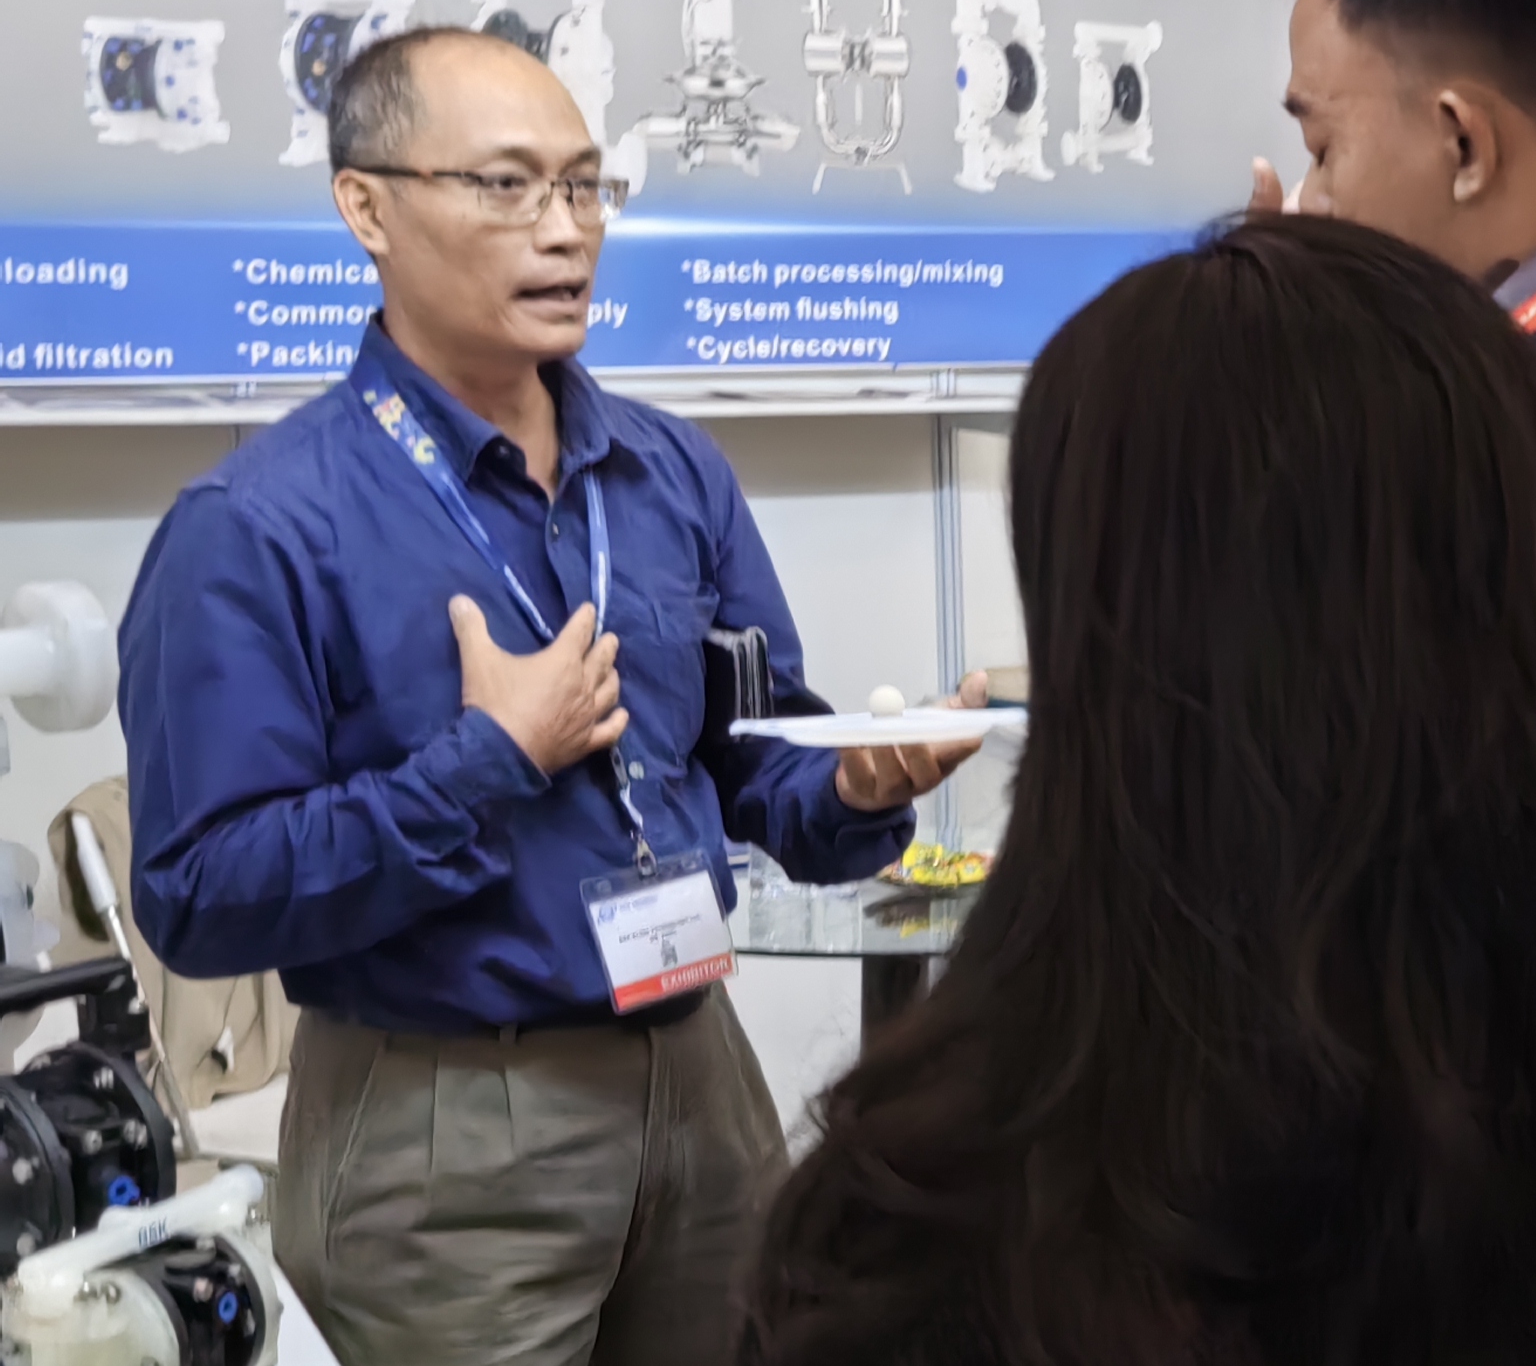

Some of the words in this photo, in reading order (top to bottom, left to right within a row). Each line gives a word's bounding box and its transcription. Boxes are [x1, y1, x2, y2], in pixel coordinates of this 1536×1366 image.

[0, 257, 129, 291] loading
[774, 258, 1004, 288] processing/mixing
[796, 296, 899, 325] flushing
[34, 342, 174, 370] filtration
